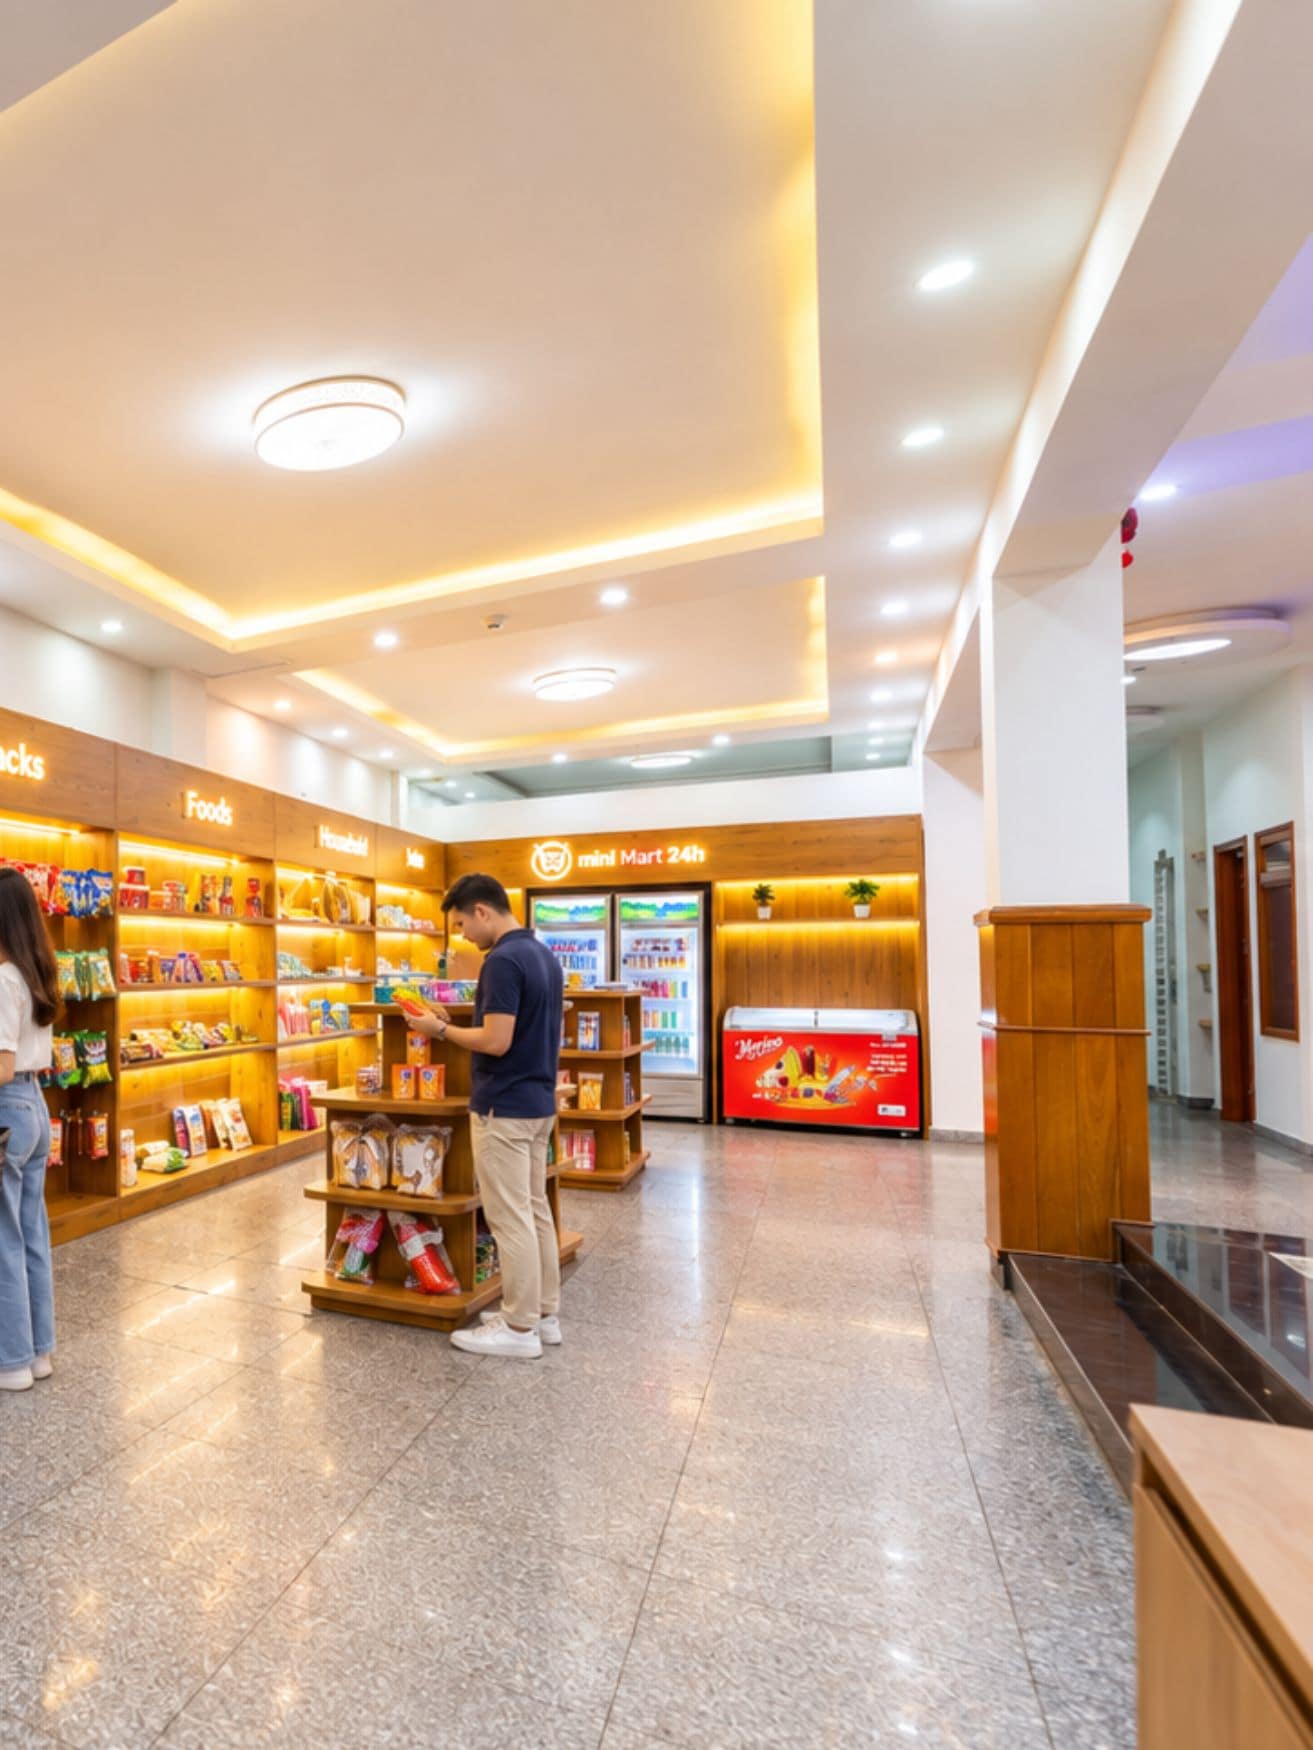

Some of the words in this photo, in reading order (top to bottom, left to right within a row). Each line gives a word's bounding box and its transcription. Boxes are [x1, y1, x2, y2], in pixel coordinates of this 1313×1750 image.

[186, 789, 233, 827] Foods
[620, 848, 663, 865] Mart
[666, 844, 705, 864] 24h
